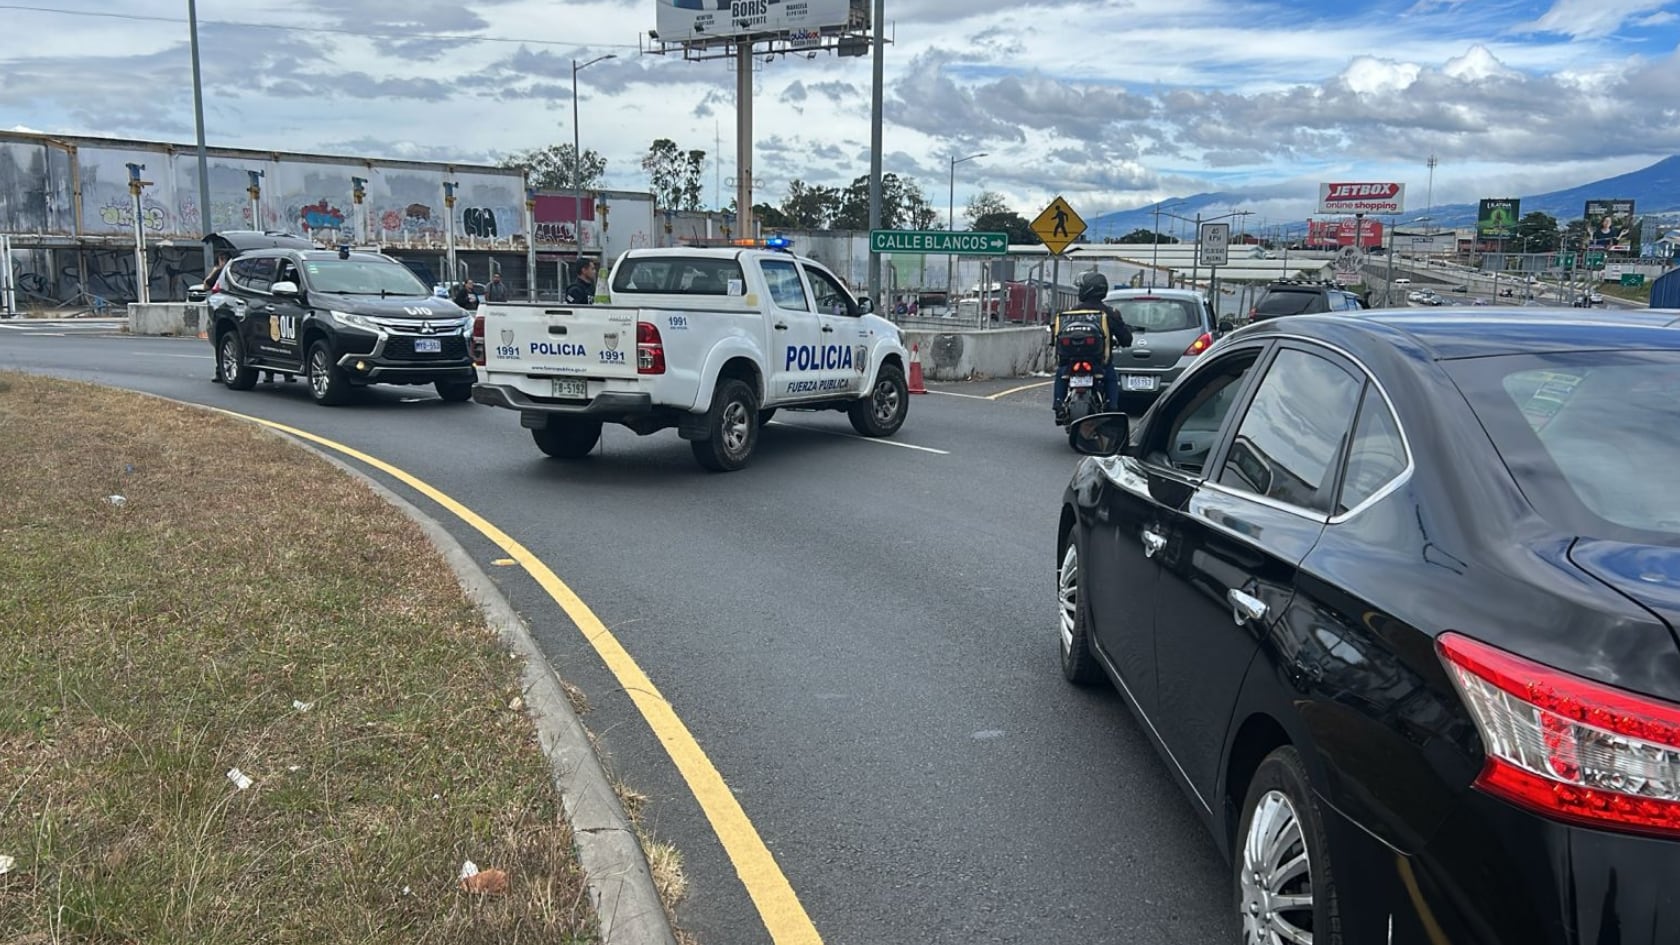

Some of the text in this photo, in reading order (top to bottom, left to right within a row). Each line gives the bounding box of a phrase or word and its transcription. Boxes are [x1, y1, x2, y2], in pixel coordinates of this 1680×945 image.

[732, 0, 767, 17] BORIS
[1331, 184, 1391, 196] JETBOX
[1354, 201, 1397, 210] shopping
[877, 234, 988, 250] CALLE BLANCOS
[668, 316, 687, 325] 1991
[280, 315, 295, 339] OIJ
[496, 346, 519, 355] 1991
[530, 343, 586, 356] POLICIA
[599, 350, 625, 360] 1991
[785, 345, 852, 371] POLICIA
[787, 381, 818, 393] FUERZA
